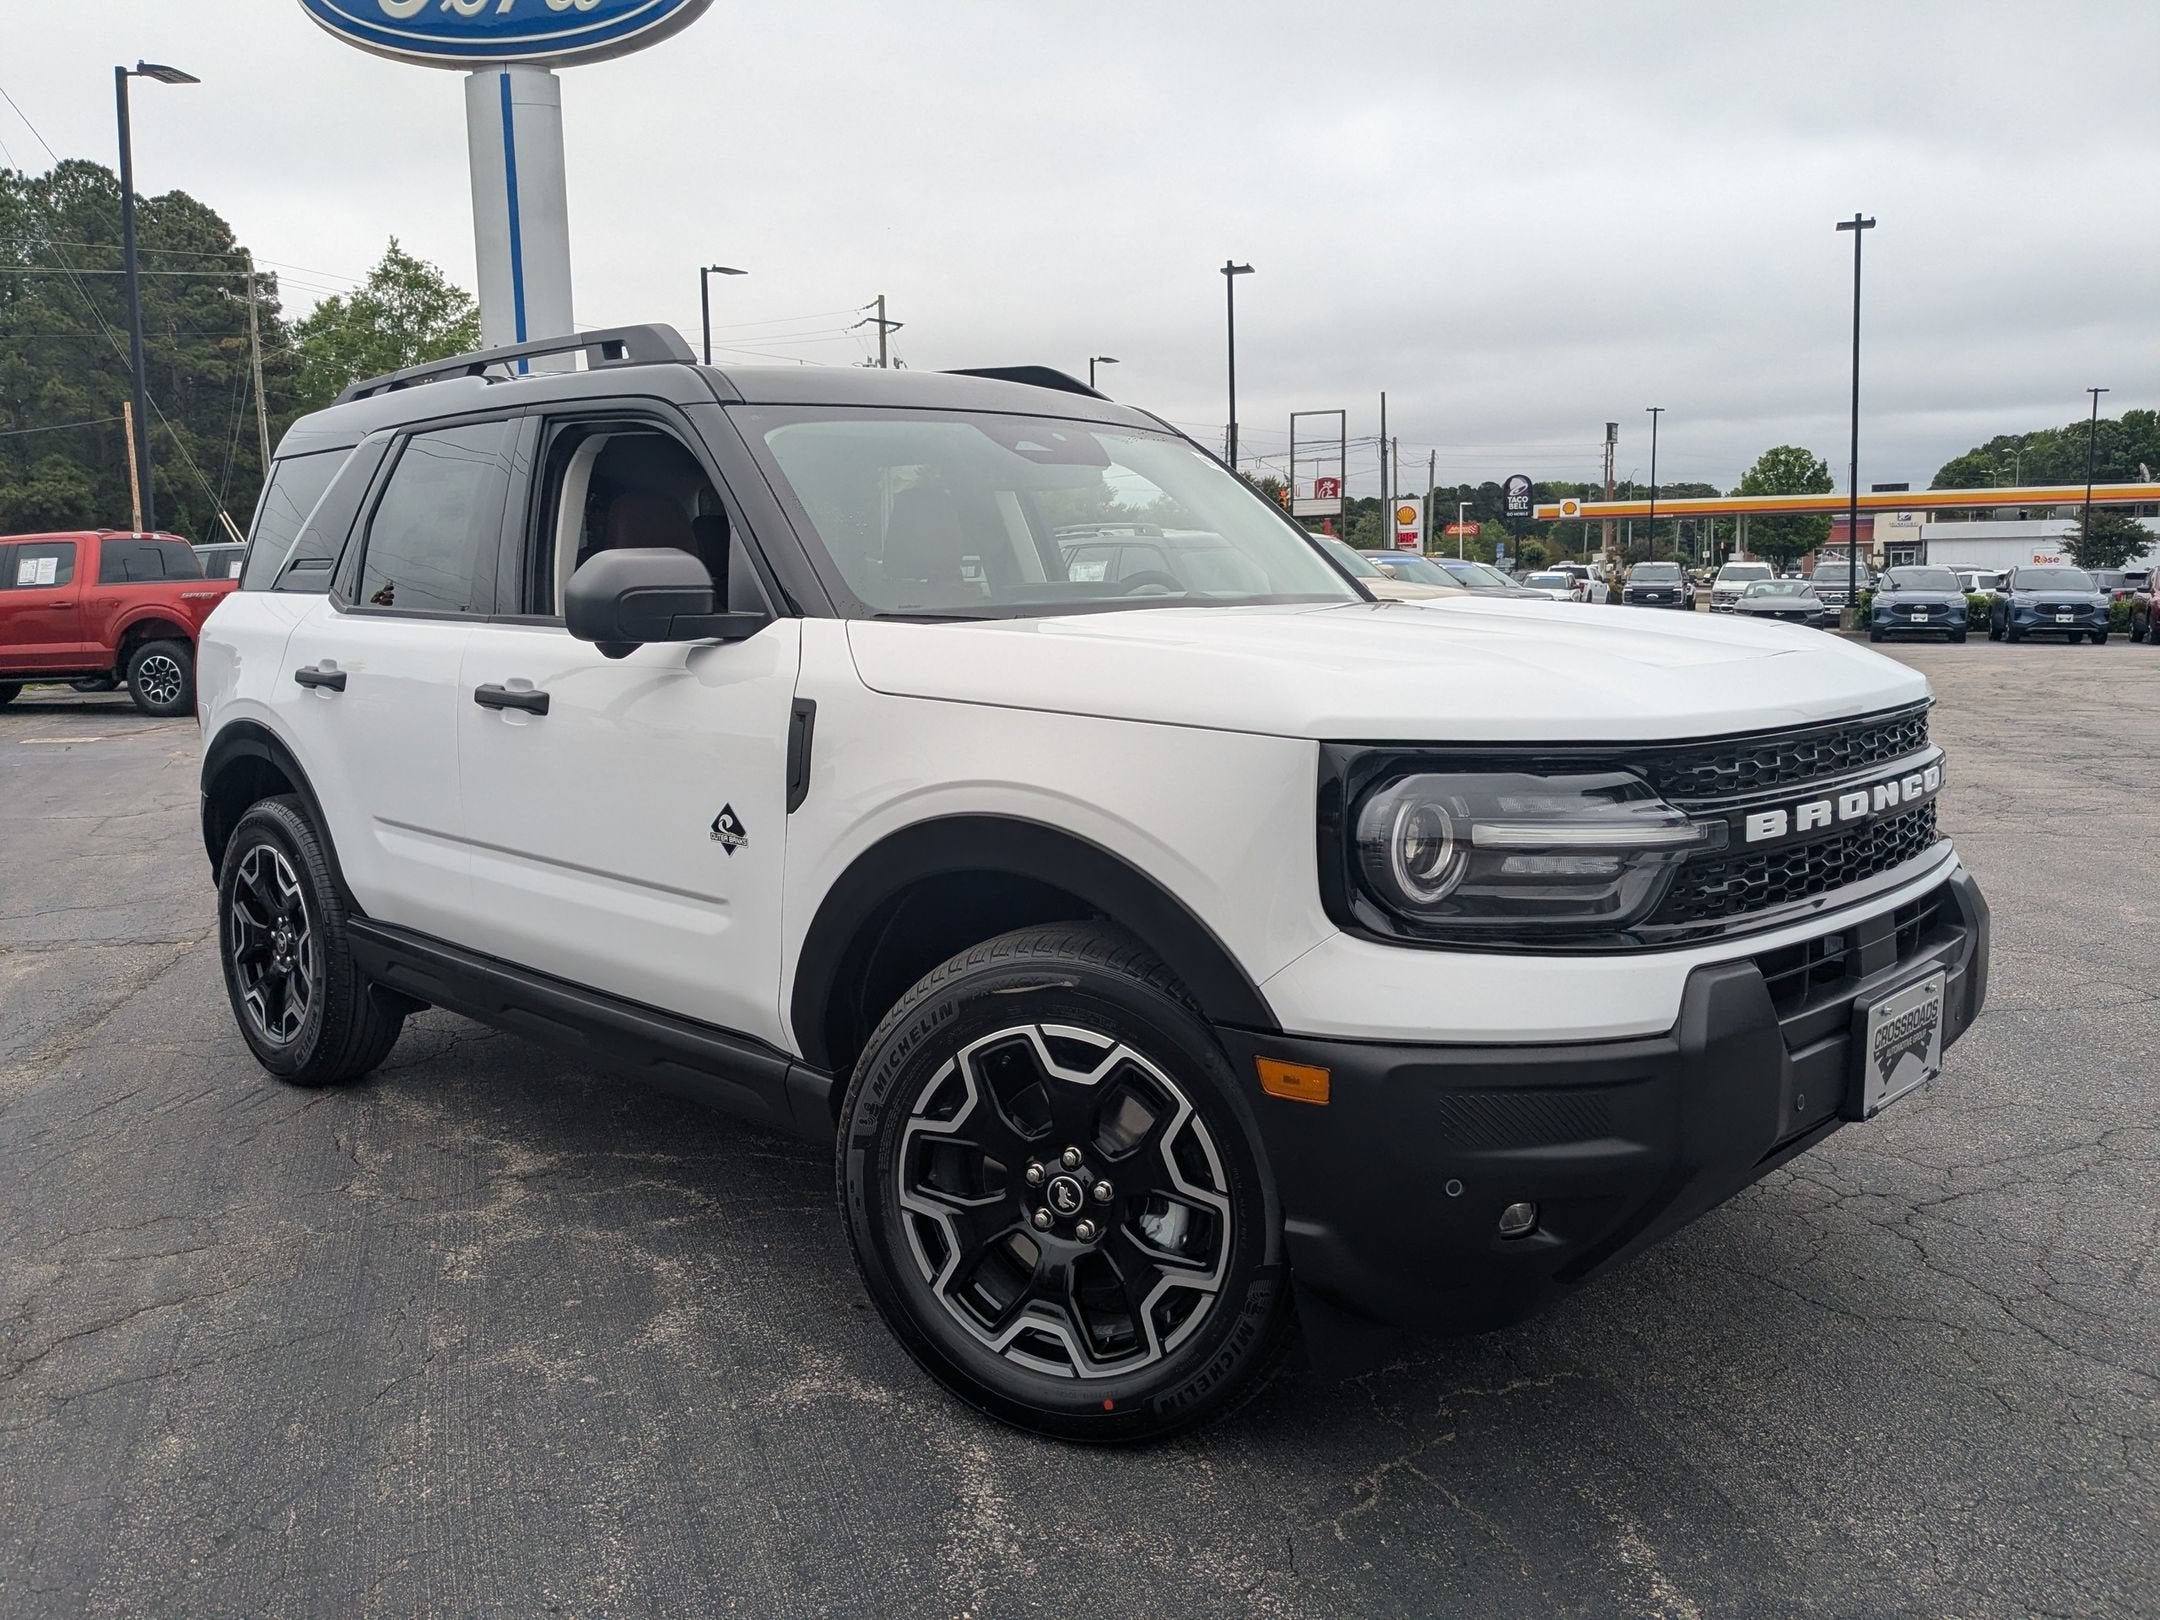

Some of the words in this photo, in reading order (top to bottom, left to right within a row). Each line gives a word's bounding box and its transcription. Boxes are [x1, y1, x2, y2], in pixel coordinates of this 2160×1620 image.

[1508, 502, 1528, 510] BELL
[1746, 765, 1941, 843] BRONCO
[871, 1000, 954, 1099] MICHELIN
[1874, 998, 1939, 1050] CROSSROADS
[1160, 1320, 1256, 1412] MICHELIN
